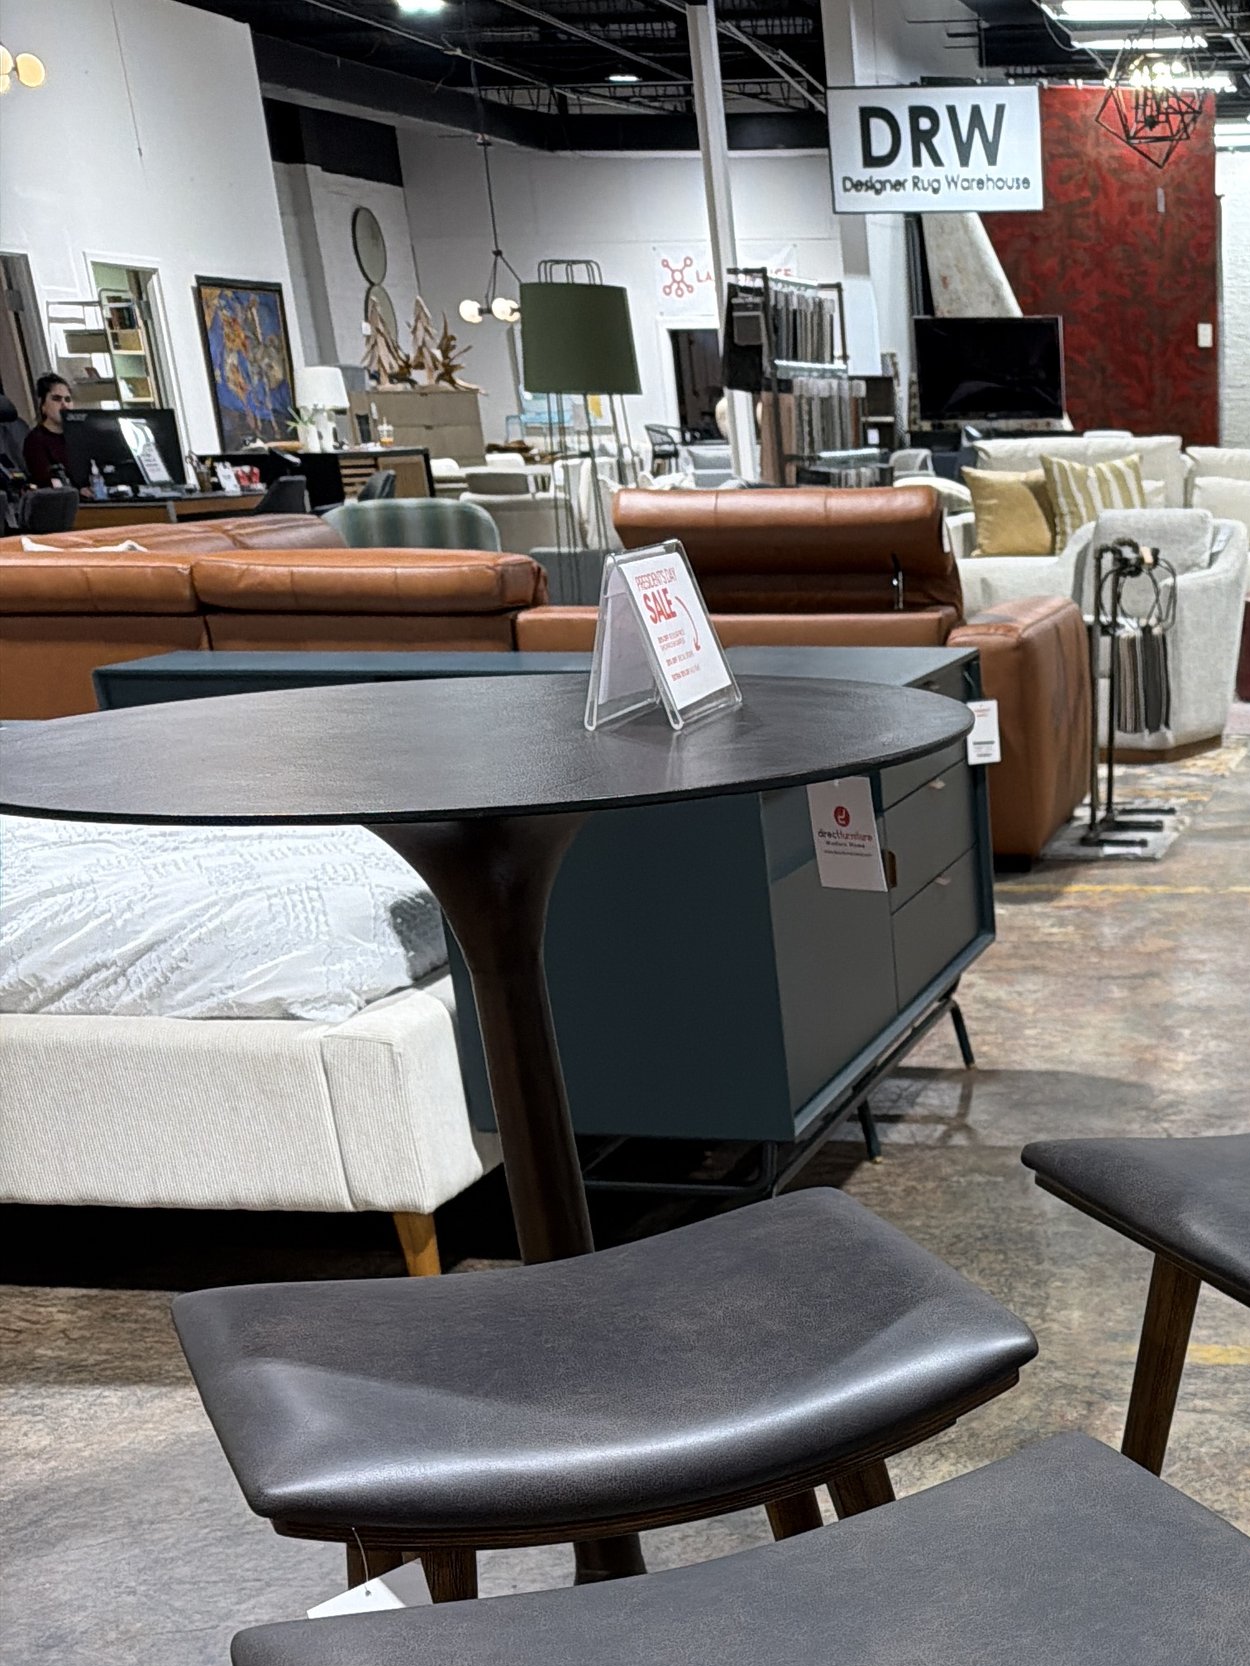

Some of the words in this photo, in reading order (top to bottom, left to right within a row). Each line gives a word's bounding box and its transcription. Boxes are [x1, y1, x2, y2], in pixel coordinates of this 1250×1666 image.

[858, 103, 1006, 169] DRW
[842, 175, 908, 196] Designer
[912, 175, 941, 195] Rug
[945, 174, 1031, 191] Warehouse
[642, 588, 677, 624] SALE
